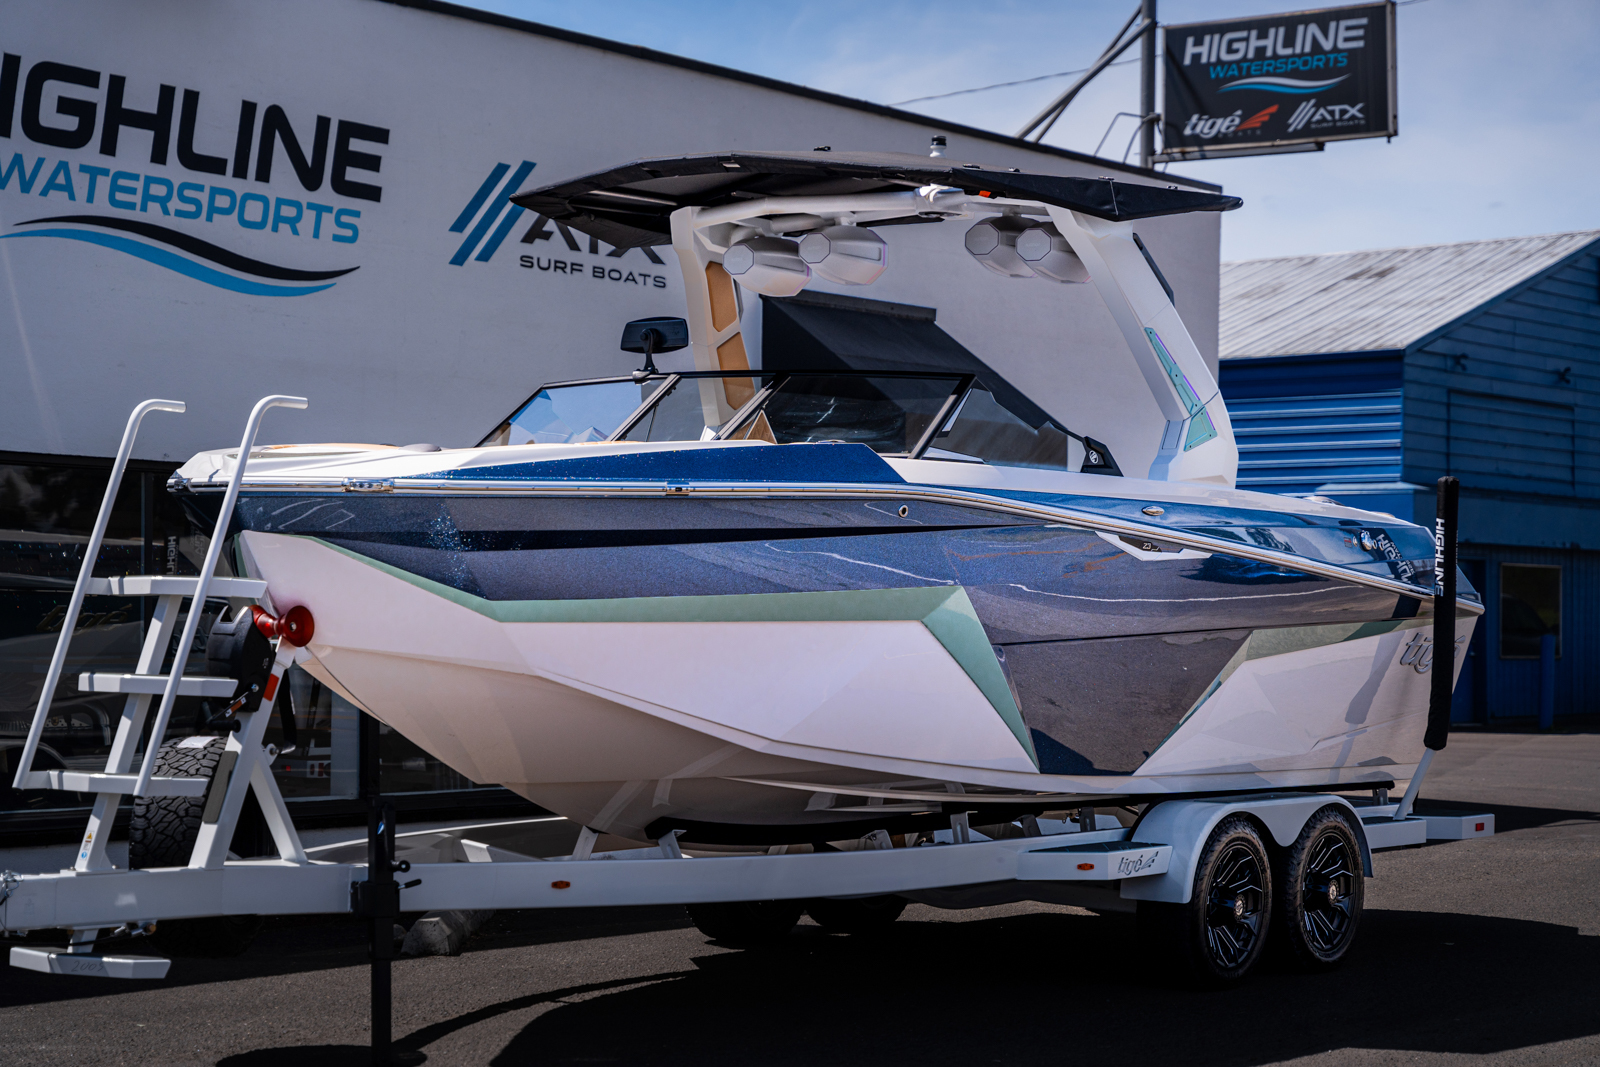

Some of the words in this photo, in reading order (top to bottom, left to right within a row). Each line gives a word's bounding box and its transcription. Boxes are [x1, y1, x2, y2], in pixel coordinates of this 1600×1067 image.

[1184, 17, 1368, 65] HIGHLINE
[1209, 52, 1349, 80] WATERSPORTS
[1183, 109, 1243, 139] tigé
[1312, 103, 1365, 120] ATX
[0, 152, 362, 245] WATERSPORTS
[519, 254, 584, 277] SURF
[592, 264, 668, 290] BOATS
[1435, 518, 1445, 597] HIGHLINE
[1118, 854, 1144, 875] tigé
